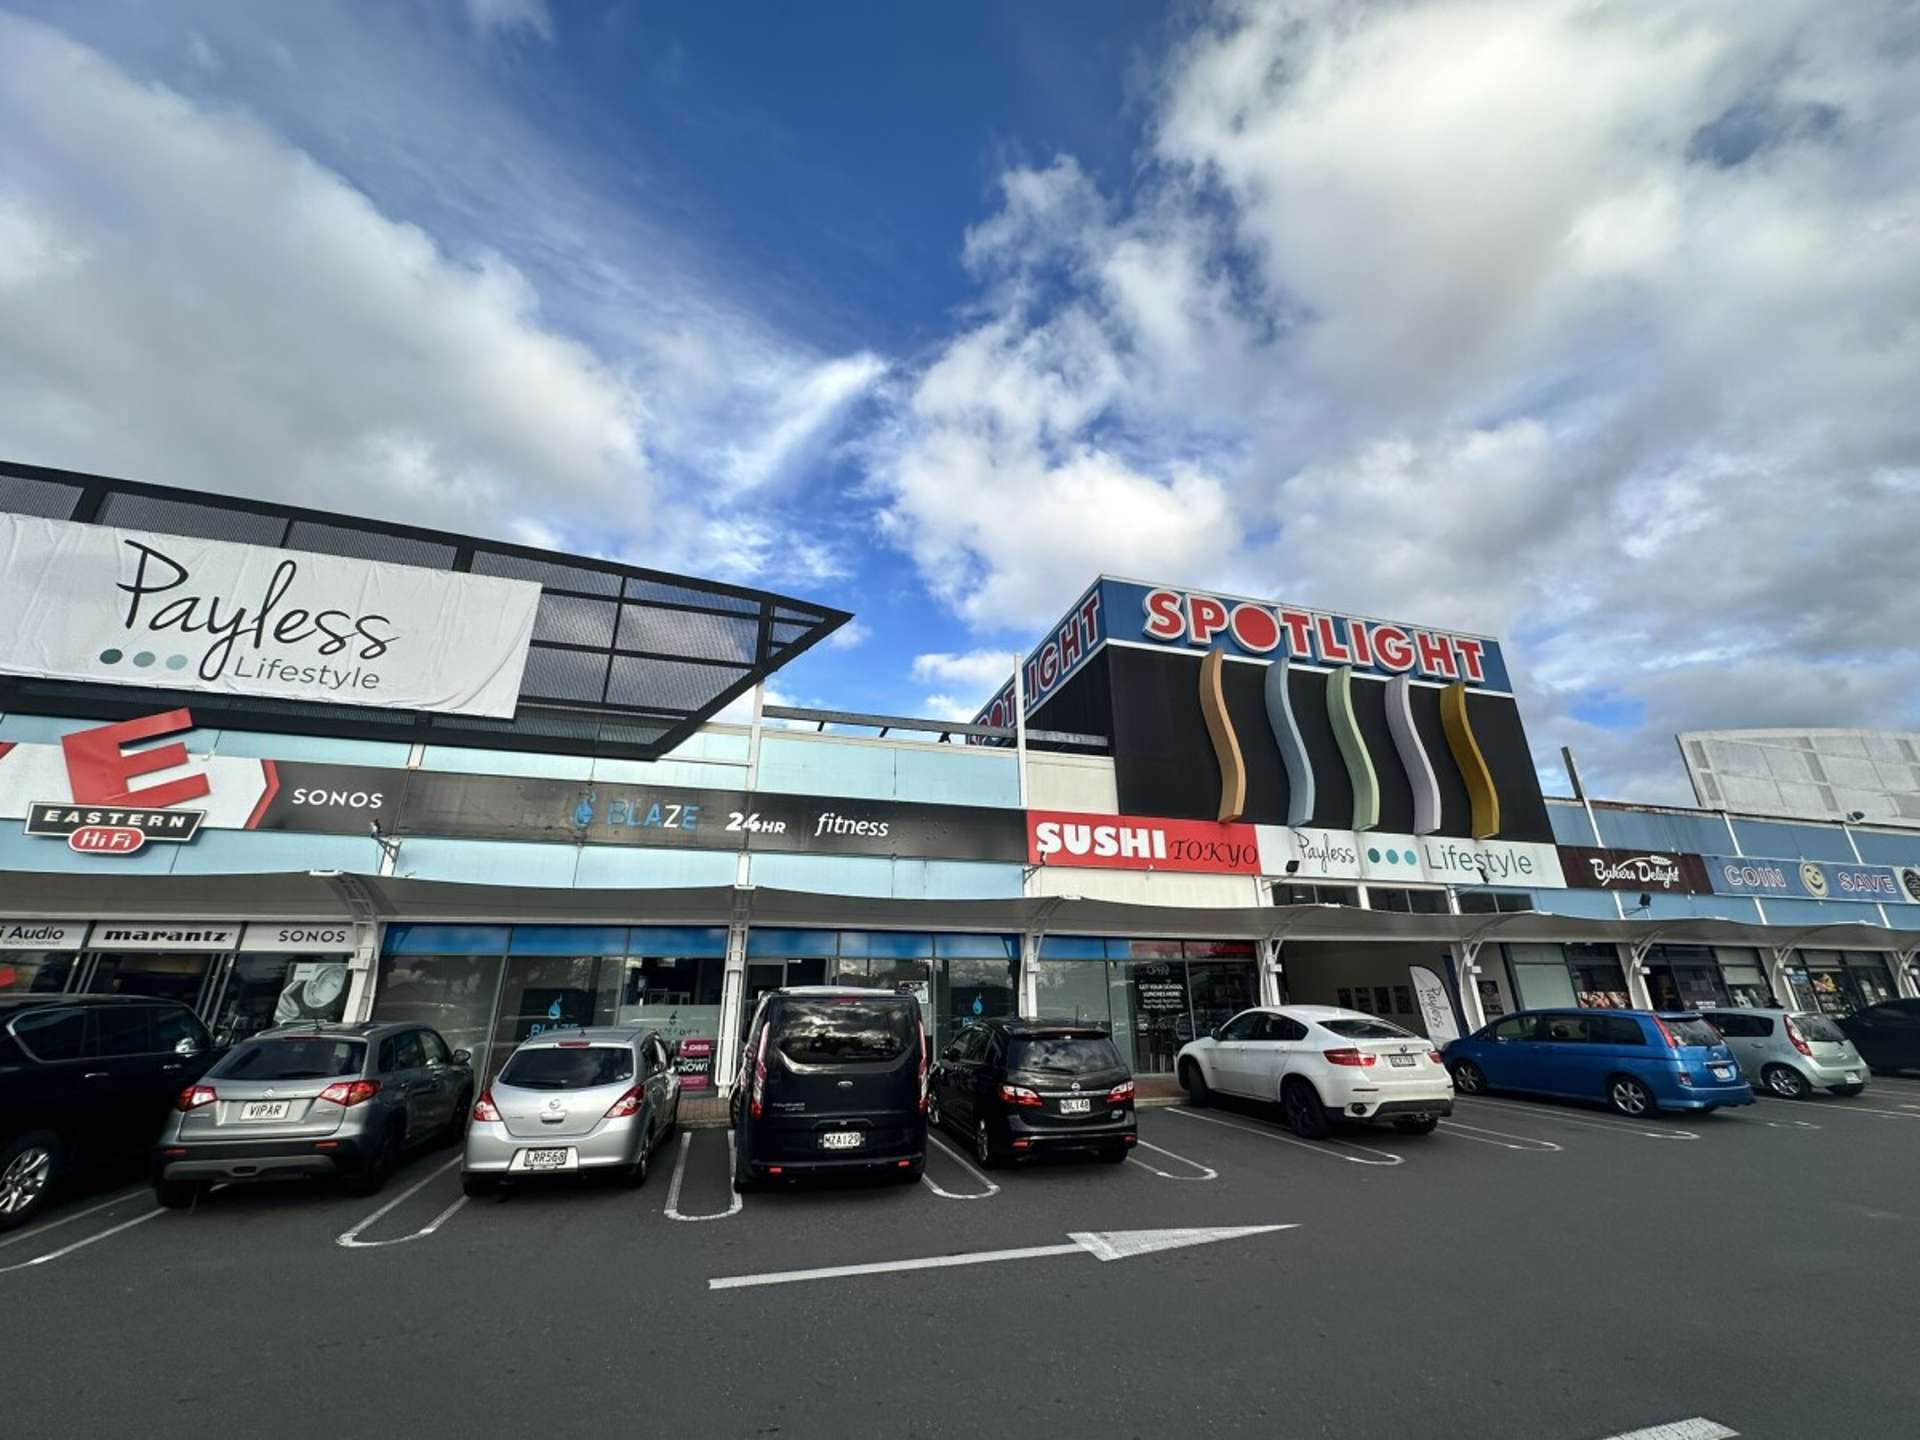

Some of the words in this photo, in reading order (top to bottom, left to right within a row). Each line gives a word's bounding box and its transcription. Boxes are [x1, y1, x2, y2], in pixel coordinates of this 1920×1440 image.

[116, 539, 399, 681] Payless
[1142, 588, 1485, 682] SPOTLIGHT
[234, 656, 380, 689] Lifestyle
[292, 788, 383, 809] SONOS
[43, 810, 186, 828] EASTERN
[607, 803, 699, 832] BLAZE
[725, 812, 786, 834] 24HR
[815, 813, 889, 837] fitness
[1035, 822, 1166, 858] SUSHI
[1170, 838, 1258, 866] TOKYO
[1297, 831, 1356, 873] Payless
[1427, 846, 1533, 877] Lifestyle
[1589, 857, 1636, 886] Bakers
[1639, 859, 1679, 888] Delight
[1724, 865, 1787, 889] COIN
[1838, 871, 1897, 894] SAVE
[8, 926, 65, 940] Audio
[104, 929, 227, 942] marantz
[278, 930, 346, 943] SONOS
